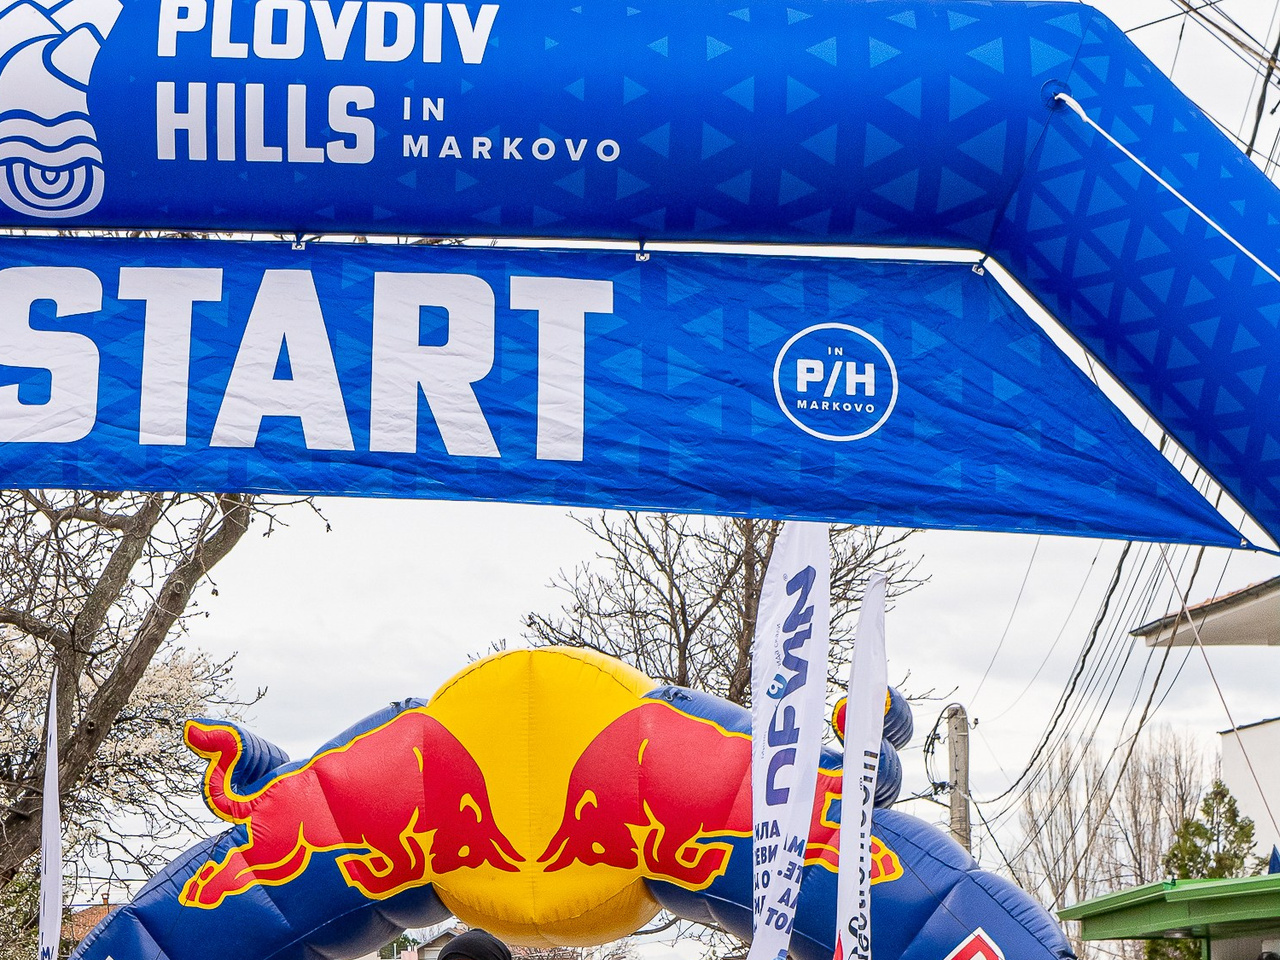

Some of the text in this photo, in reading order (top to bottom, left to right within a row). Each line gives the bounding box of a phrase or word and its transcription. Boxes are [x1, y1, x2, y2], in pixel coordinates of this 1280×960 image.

[157, 0, 500, 65] PLOVDIV
[156, 81, 375, 164] HILLS
[403, 97, 444, 121] IN
[403, 135, 621, 163] MARKOVO
[828, 346, 843, 356] IN
[796, 358, 875, 398] P/H
[797, 399, 875, 413] MARKOVO
